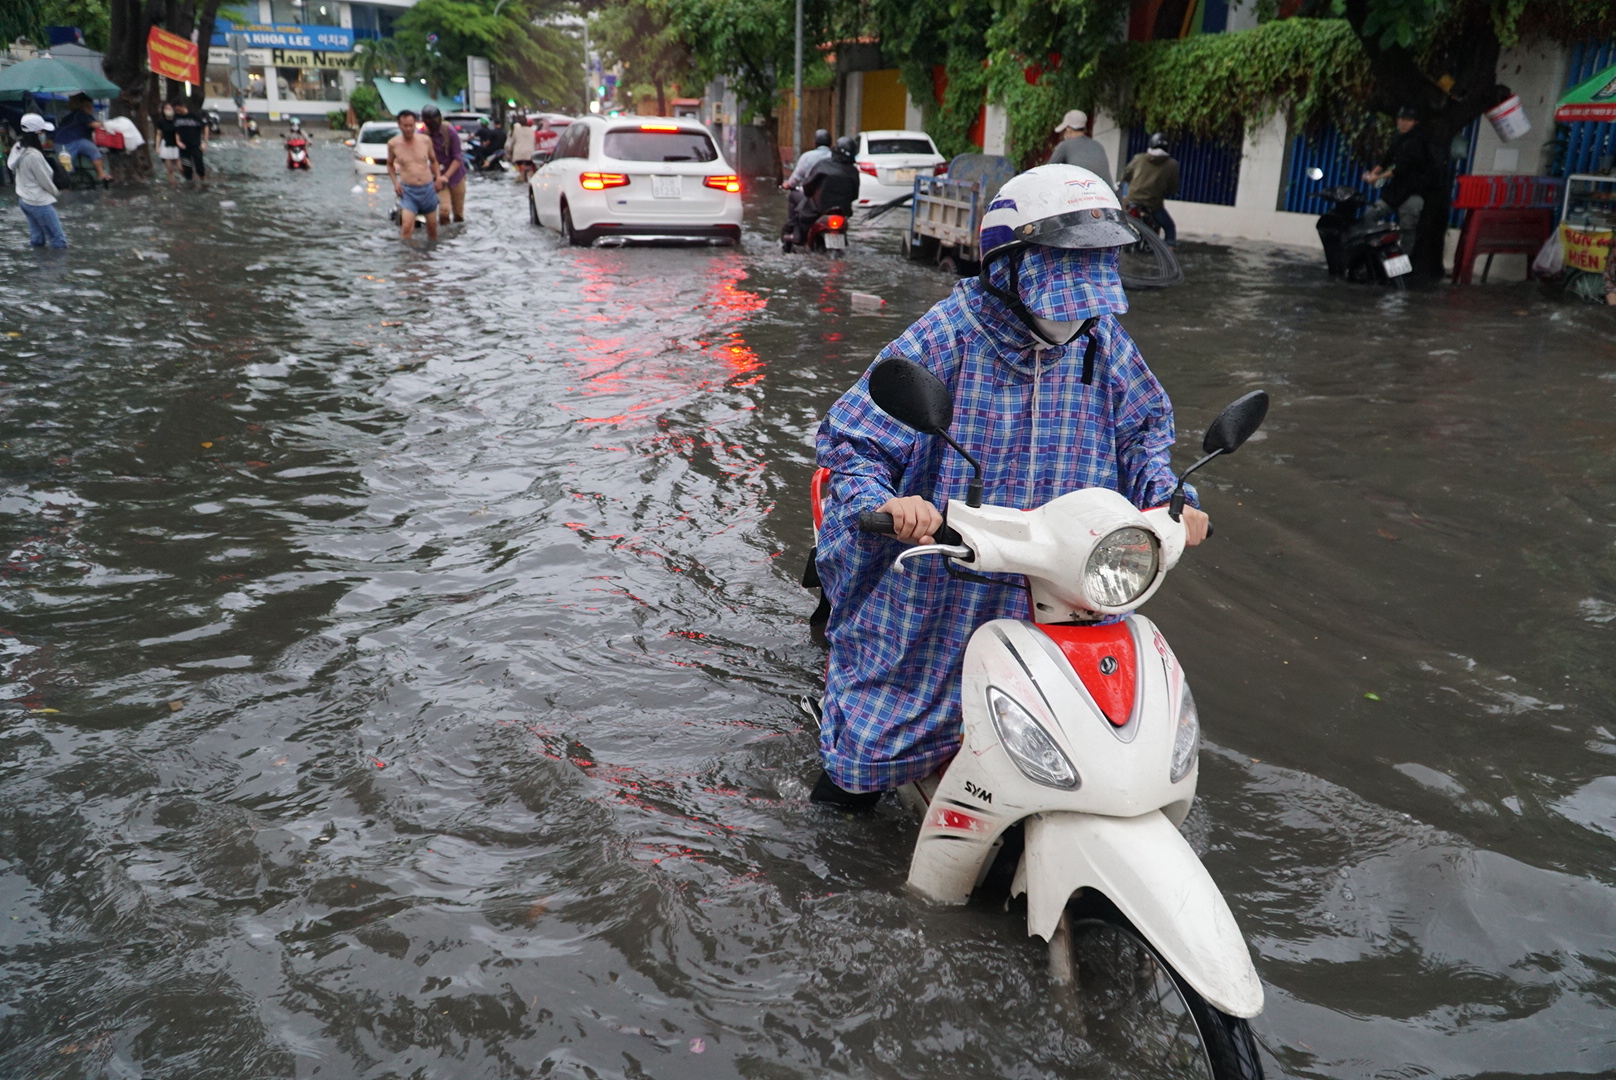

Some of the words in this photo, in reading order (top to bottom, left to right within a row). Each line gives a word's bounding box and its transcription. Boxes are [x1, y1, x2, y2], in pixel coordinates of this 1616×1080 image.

[253, 33, 286, 46] KHOA
[289, 35, 312, 47] LEE
[317, 33, 349, 47] 이치과
[964, 780, 992, 804] SYM
